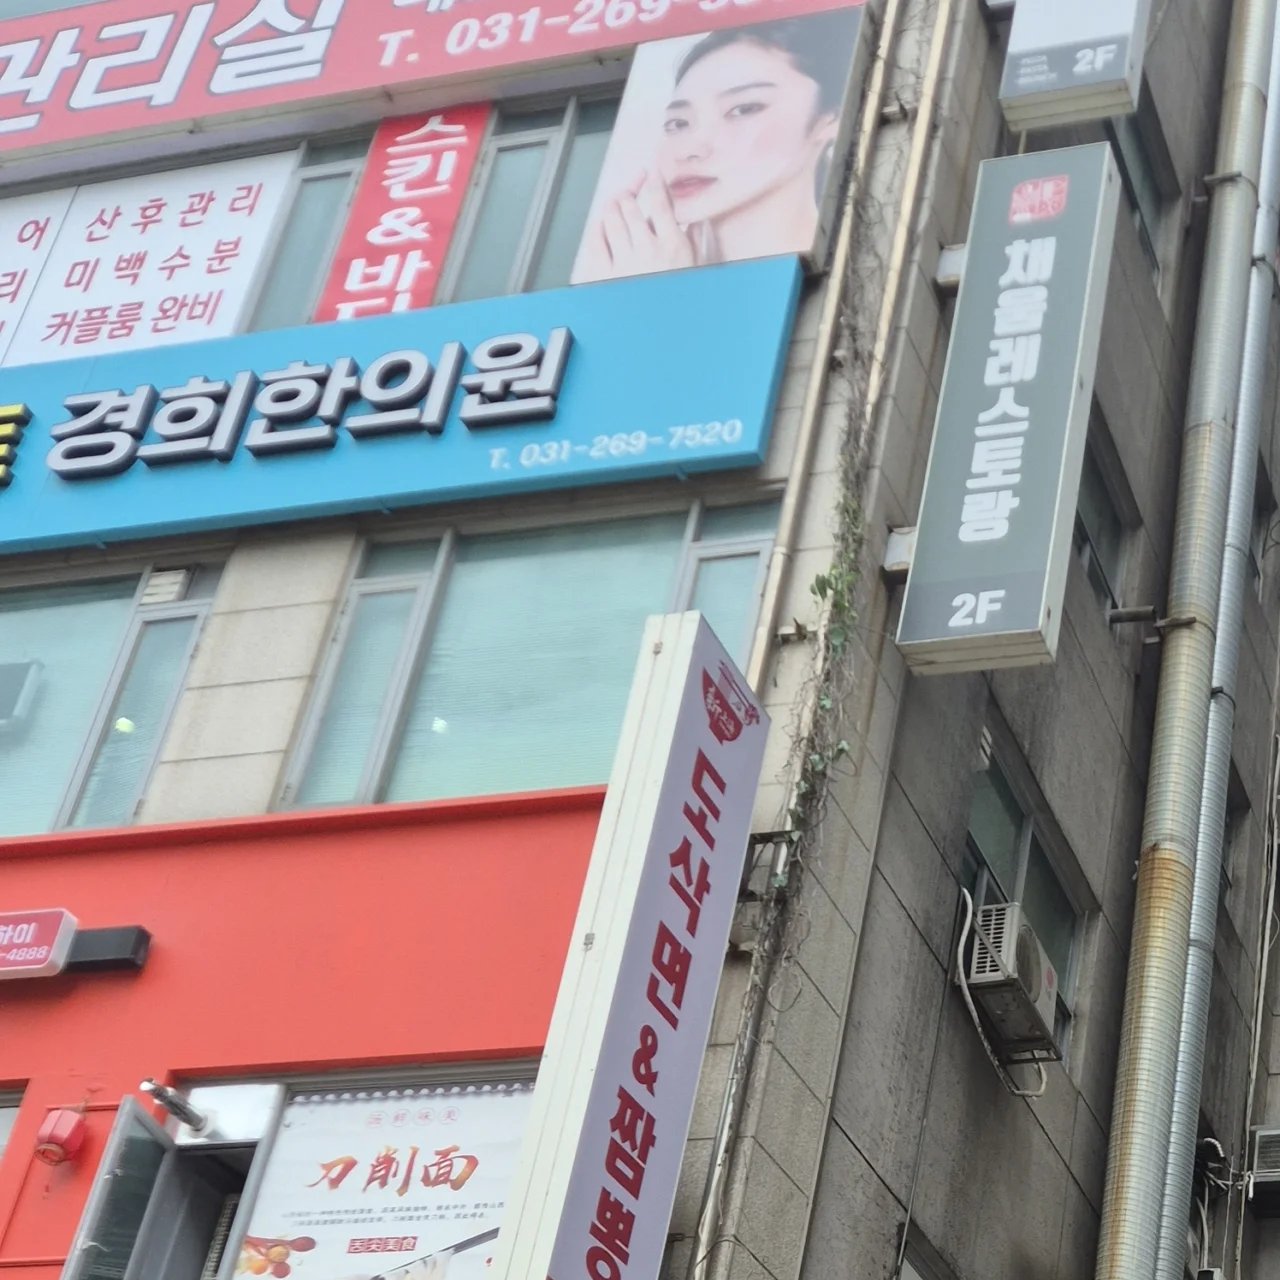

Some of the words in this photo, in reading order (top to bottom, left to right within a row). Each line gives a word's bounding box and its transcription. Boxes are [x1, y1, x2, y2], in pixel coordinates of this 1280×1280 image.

[378, 28, 420, 67] T.
[1072, 43, 1118, 77] 2F
[41, 301, 145, 346] 커플룸
[151, 289, 224, 334] 완비
[46, 326, 574, 480] 경희한의원
[519, 419, 743, 467] 031-269-7520
[948, 589, 1006, 628] 2F
[306, 1144, 480, 1197] 刀削面
